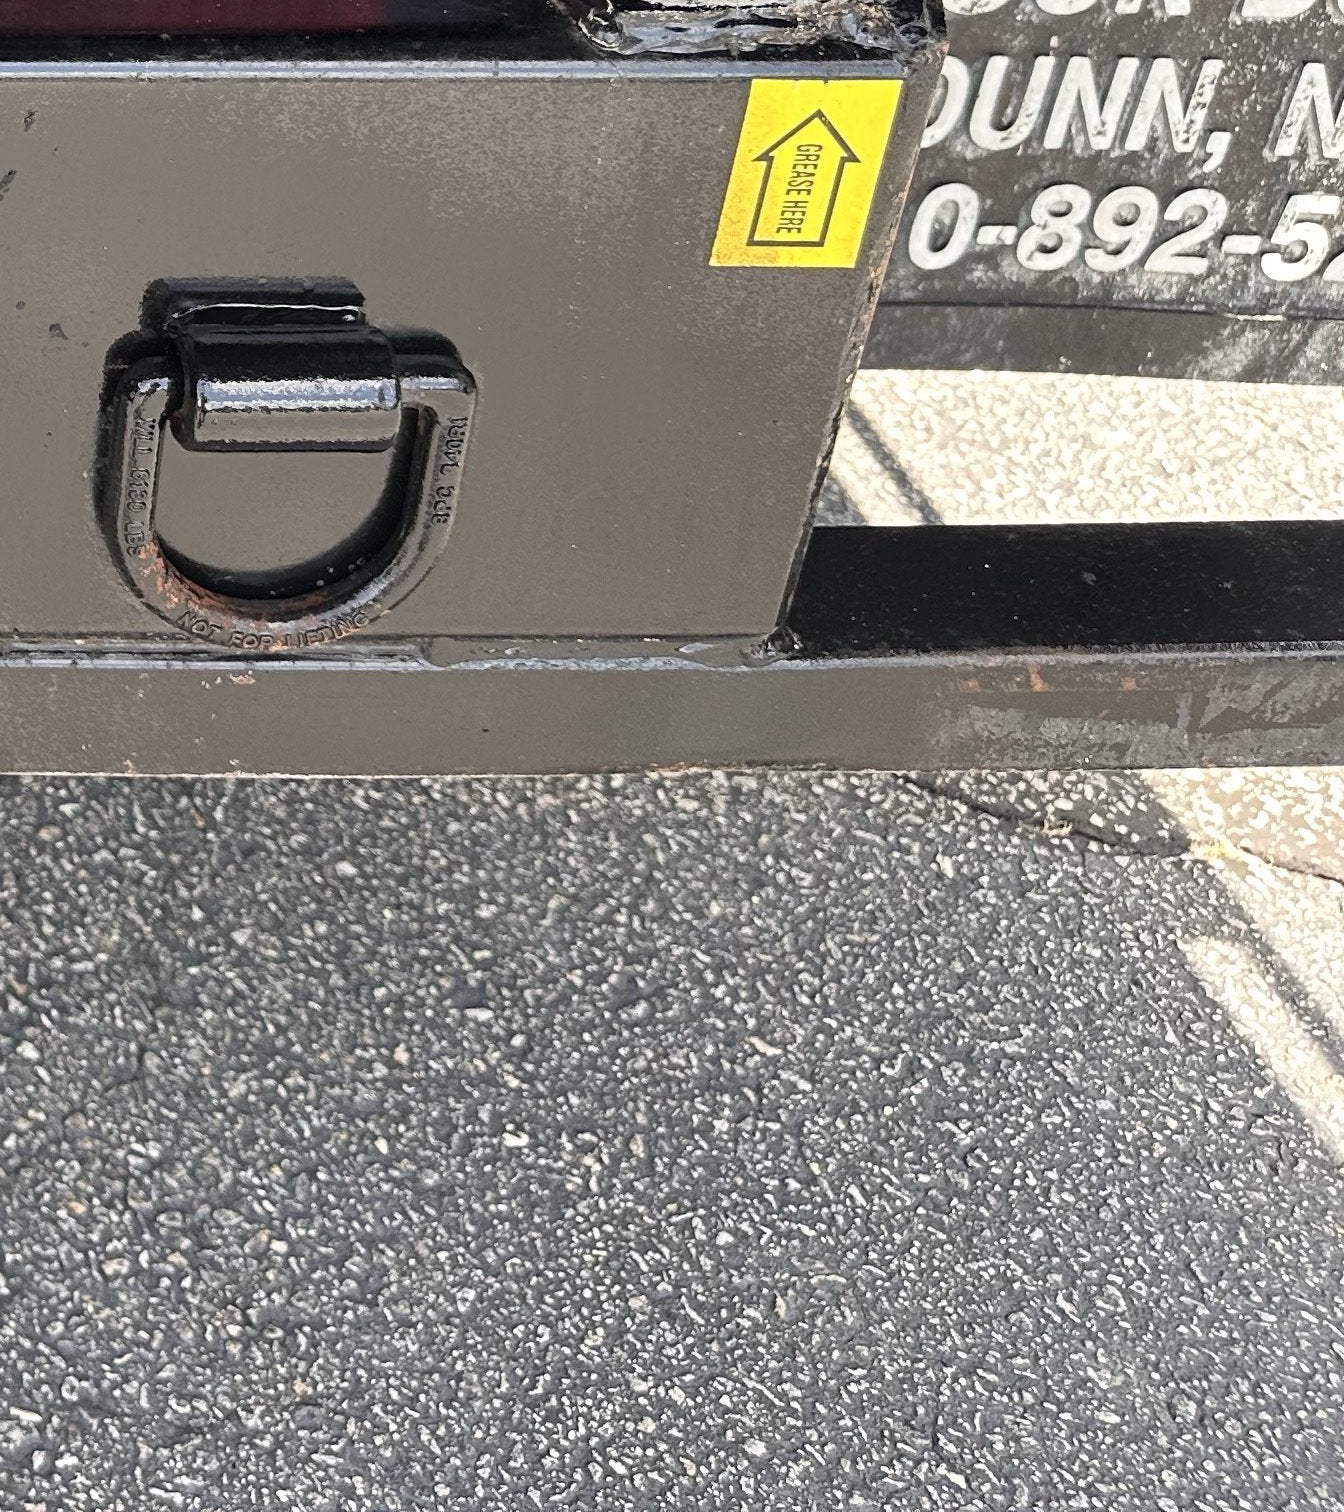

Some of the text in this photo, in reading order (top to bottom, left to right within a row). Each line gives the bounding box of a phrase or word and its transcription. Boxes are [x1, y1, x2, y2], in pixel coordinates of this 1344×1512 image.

[776, 143, 823, 234] GREASE HERE
[176, 609, 223, 637] NOT
[229, 630, 274, 650] FOR
